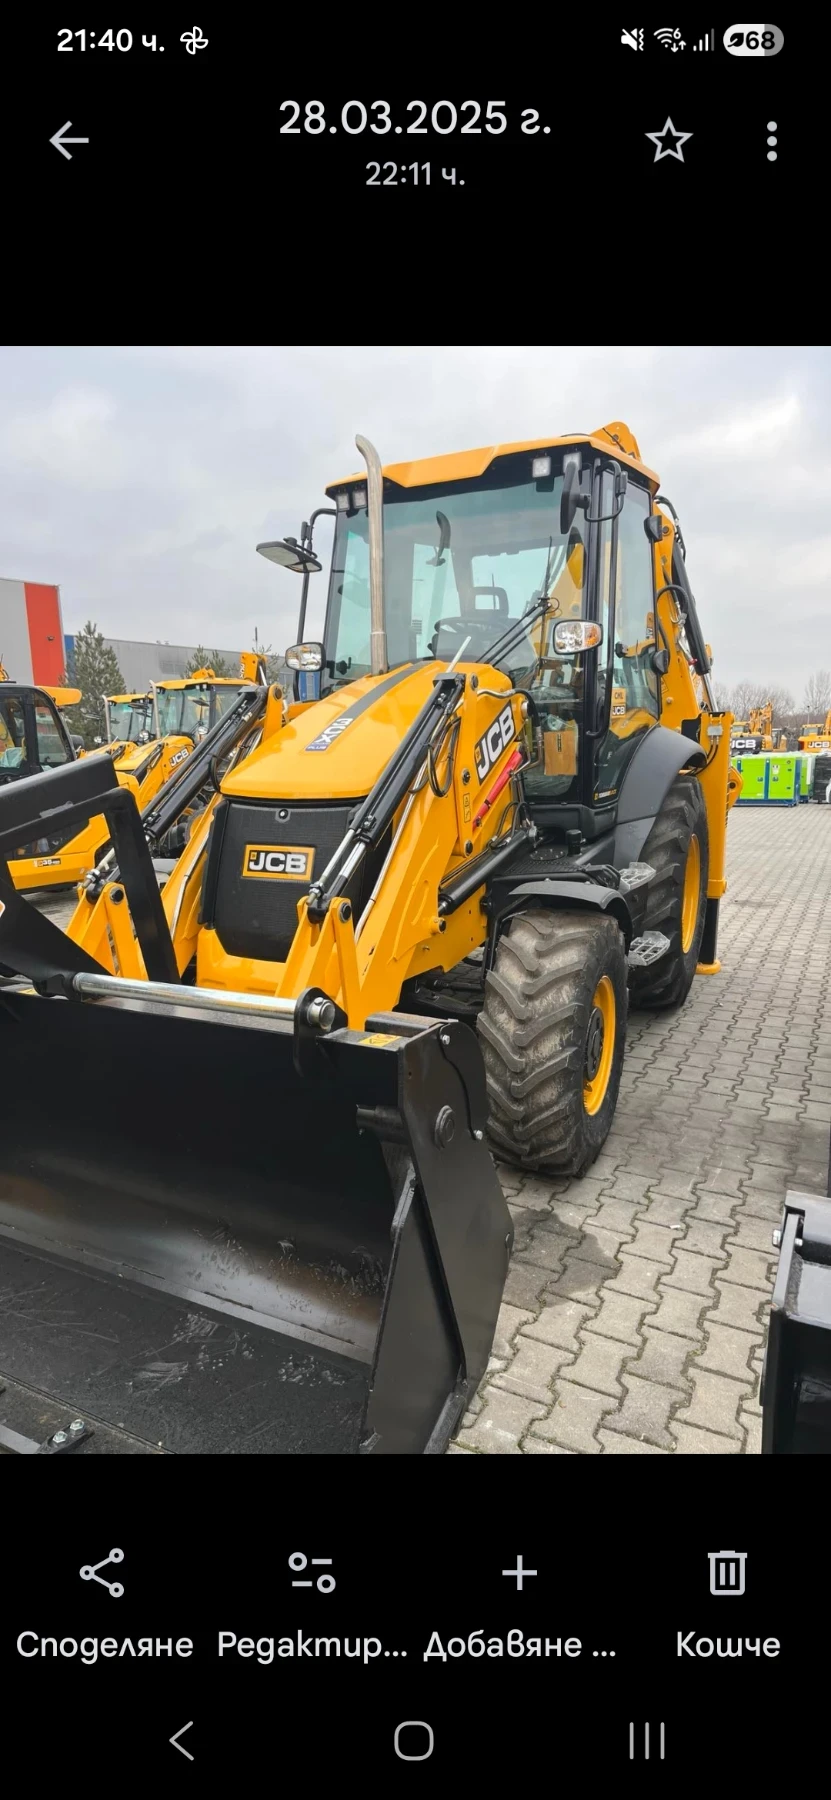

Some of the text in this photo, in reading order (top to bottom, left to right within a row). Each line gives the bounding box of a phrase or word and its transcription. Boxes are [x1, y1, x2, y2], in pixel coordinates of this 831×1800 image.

[612, 706, 625, 715] JCB
[313, 718, 354, 743] 3CX
[478, 705, 515, 779] JCB
[807, 740, 830, 749] JCB
[171, 748, 189, 767] JCB
[249, 852, 307, 873] JCB
